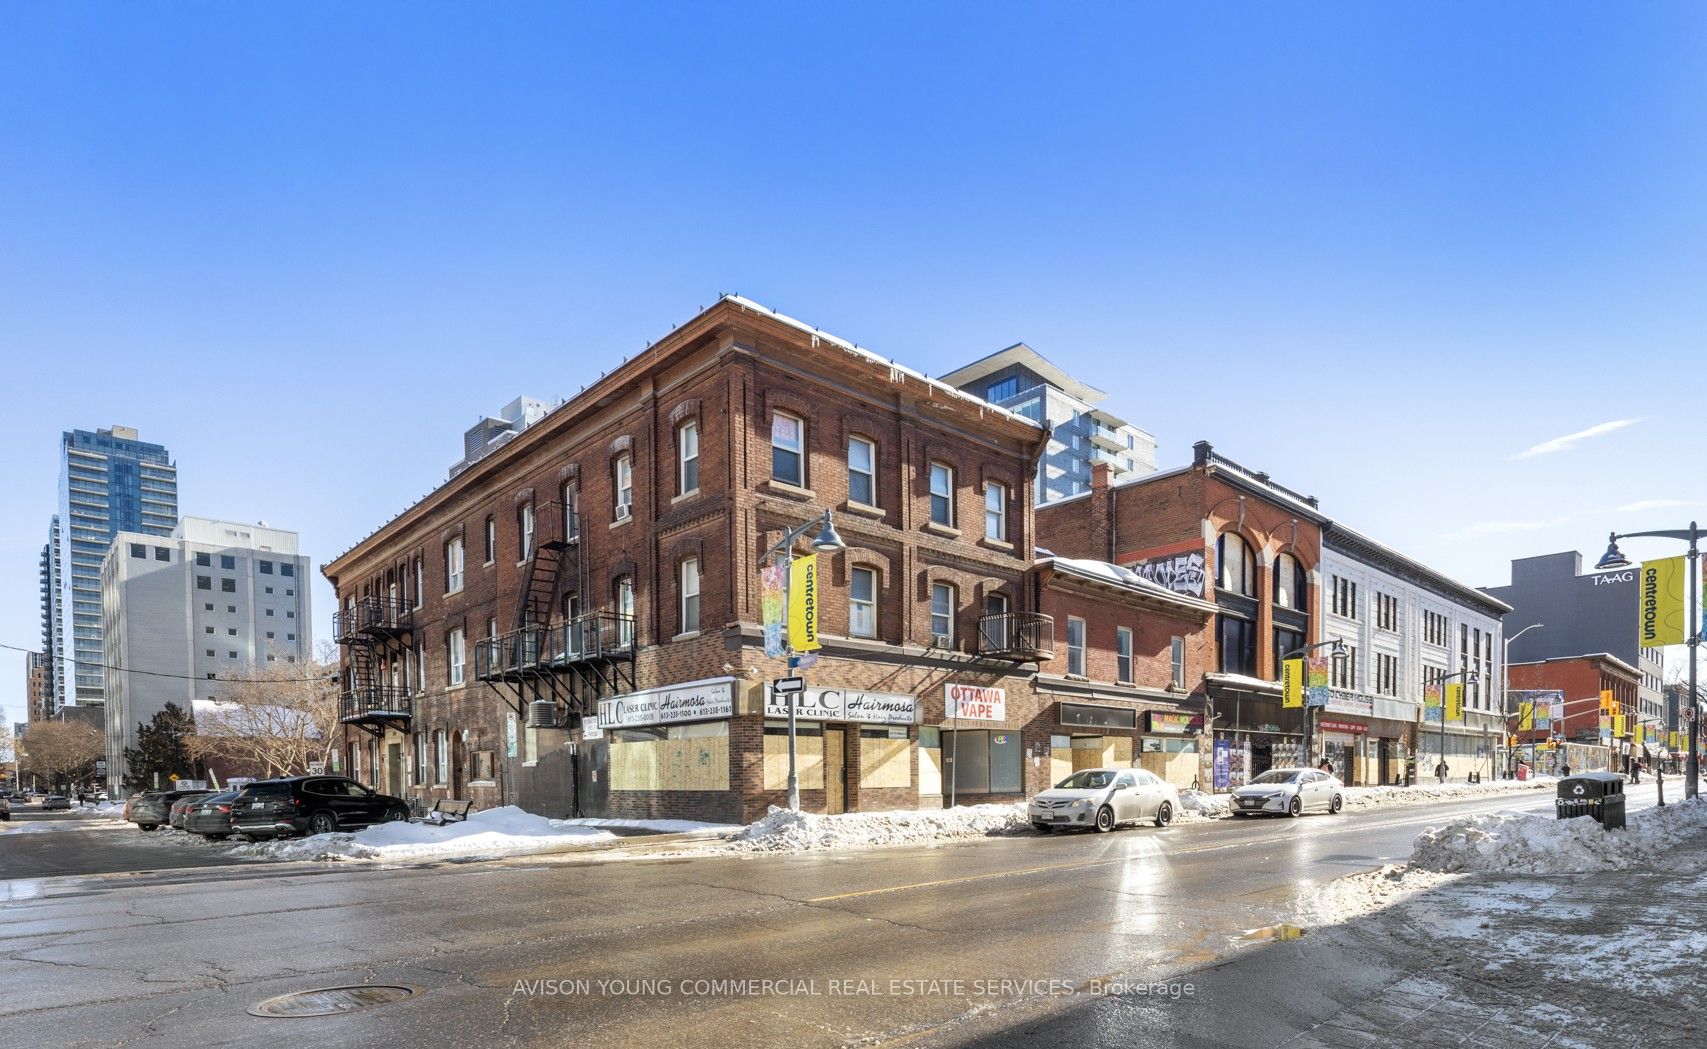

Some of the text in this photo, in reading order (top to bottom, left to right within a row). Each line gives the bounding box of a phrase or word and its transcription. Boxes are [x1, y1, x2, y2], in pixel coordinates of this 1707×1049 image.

[1591, 571, 1634, 586] TAAG
[806, 564, 814, 642] centretown
[1644, 568, 1657, 640] centretown
[661, 693, 705, 710] Hairmosa
[847, 693, 914, 713] Hairmosa
[951, 686, 1000, 704] OTTAWA
[599, 700, 624, 725] HLC
[768, 706, 840, 718] LASR CLINIC
[962, 702, 992, 718] VAPE
